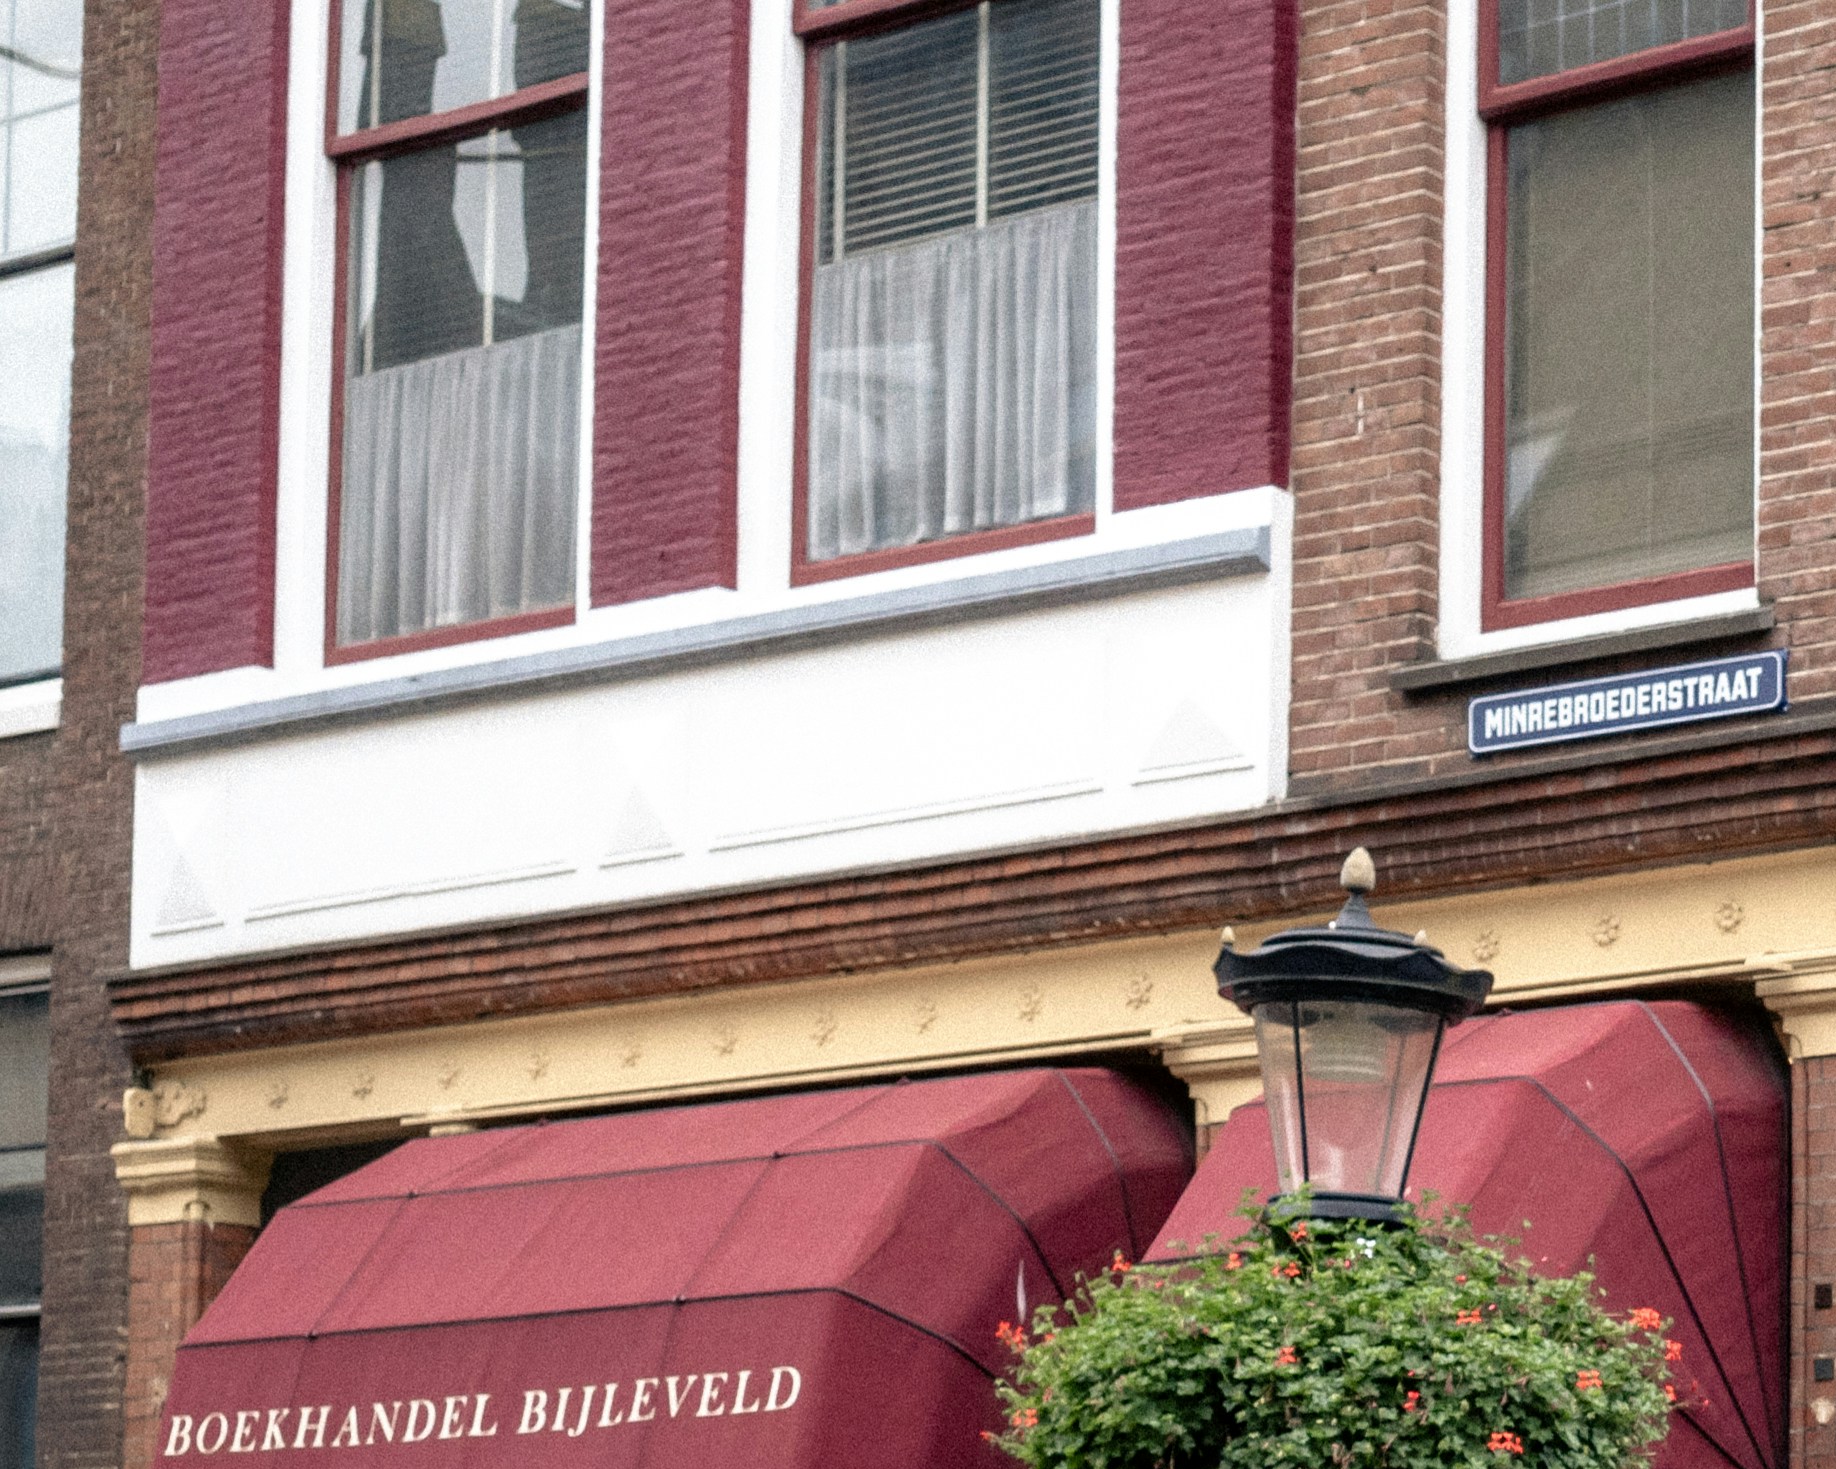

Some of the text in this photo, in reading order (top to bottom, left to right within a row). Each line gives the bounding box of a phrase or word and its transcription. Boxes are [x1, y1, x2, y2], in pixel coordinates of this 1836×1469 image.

[1484, 667, 1764, 741] MINREBROEDERSTRAAT
[163, 1365, 803, 1457] BOEKHANDEL BIJLEVELD
